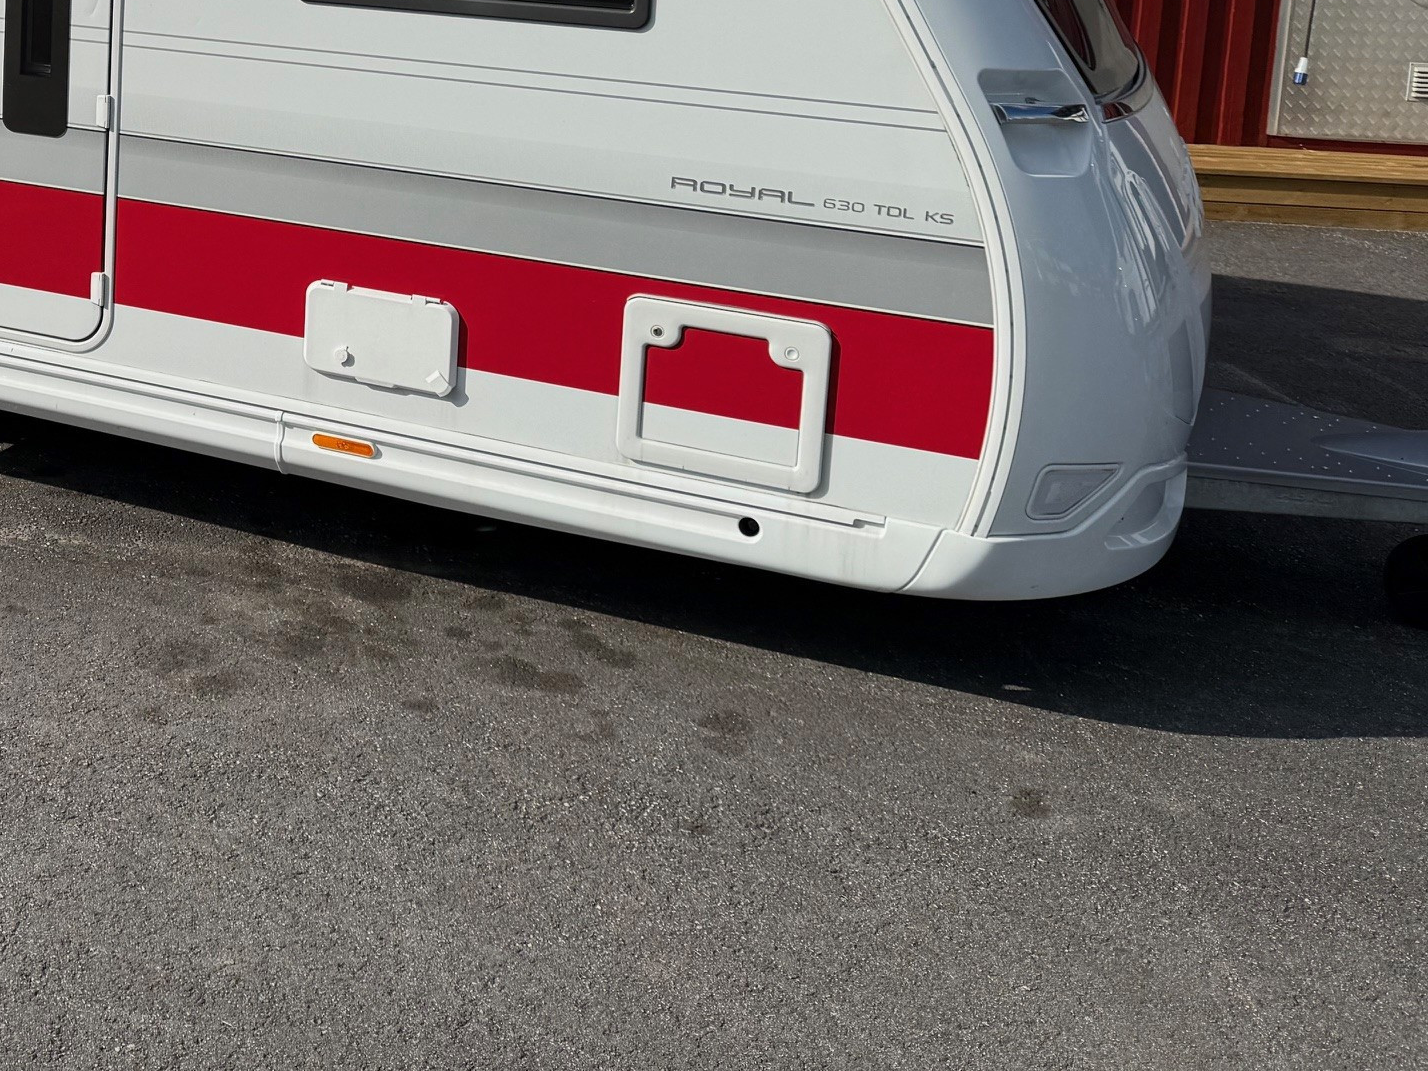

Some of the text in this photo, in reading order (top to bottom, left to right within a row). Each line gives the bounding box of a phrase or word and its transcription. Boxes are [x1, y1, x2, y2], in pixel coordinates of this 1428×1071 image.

[670, 176, 955, 225] ROYAL 630 TDL KS
